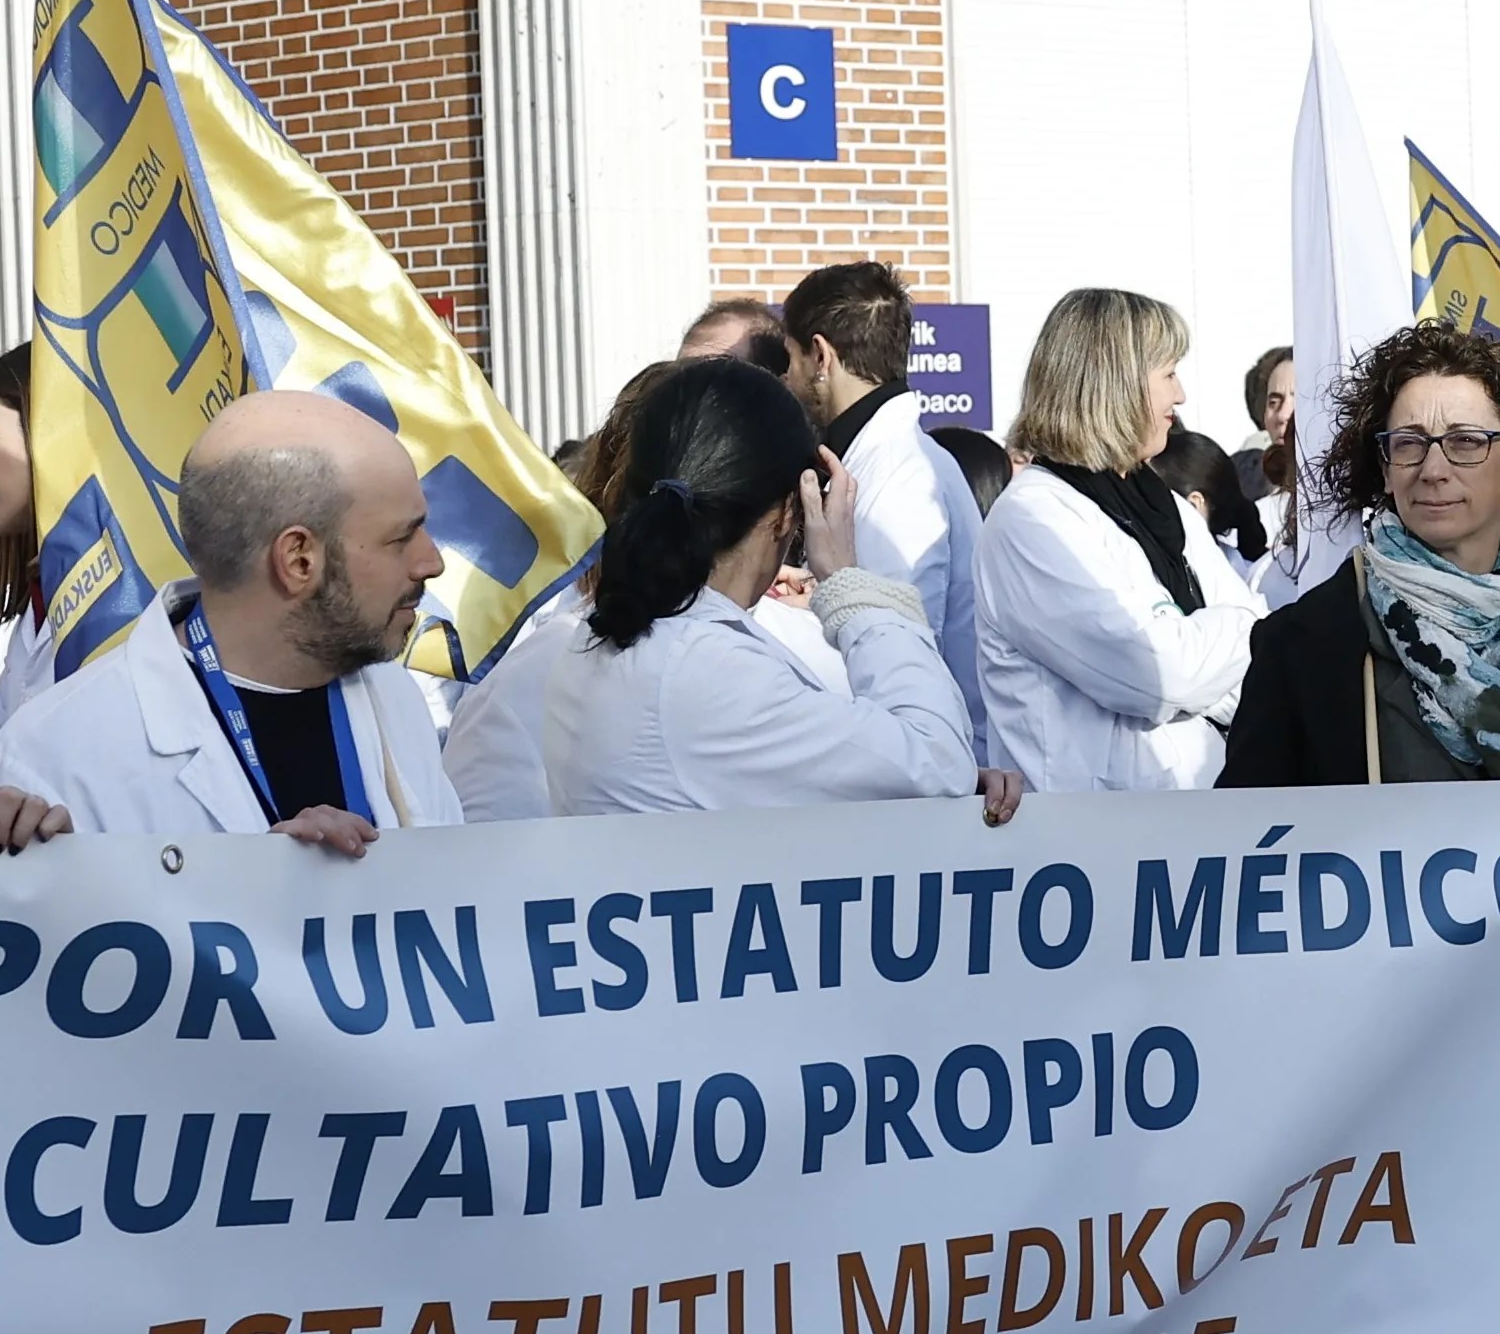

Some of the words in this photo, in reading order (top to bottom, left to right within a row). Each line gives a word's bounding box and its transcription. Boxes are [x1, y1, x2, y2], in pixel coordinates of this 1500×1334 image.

[758, 64, 807, 120] C
[907, 352, 962, 373] unea
[914, 389, 973, 414] baco
[303, 905, 493, 1037] UN
[523, 863, 1094, 1020] ESTATUTO
[801, 1025, 1201, 1174] PROPIO
[1243, 1150, 1417, 1263] ETA
